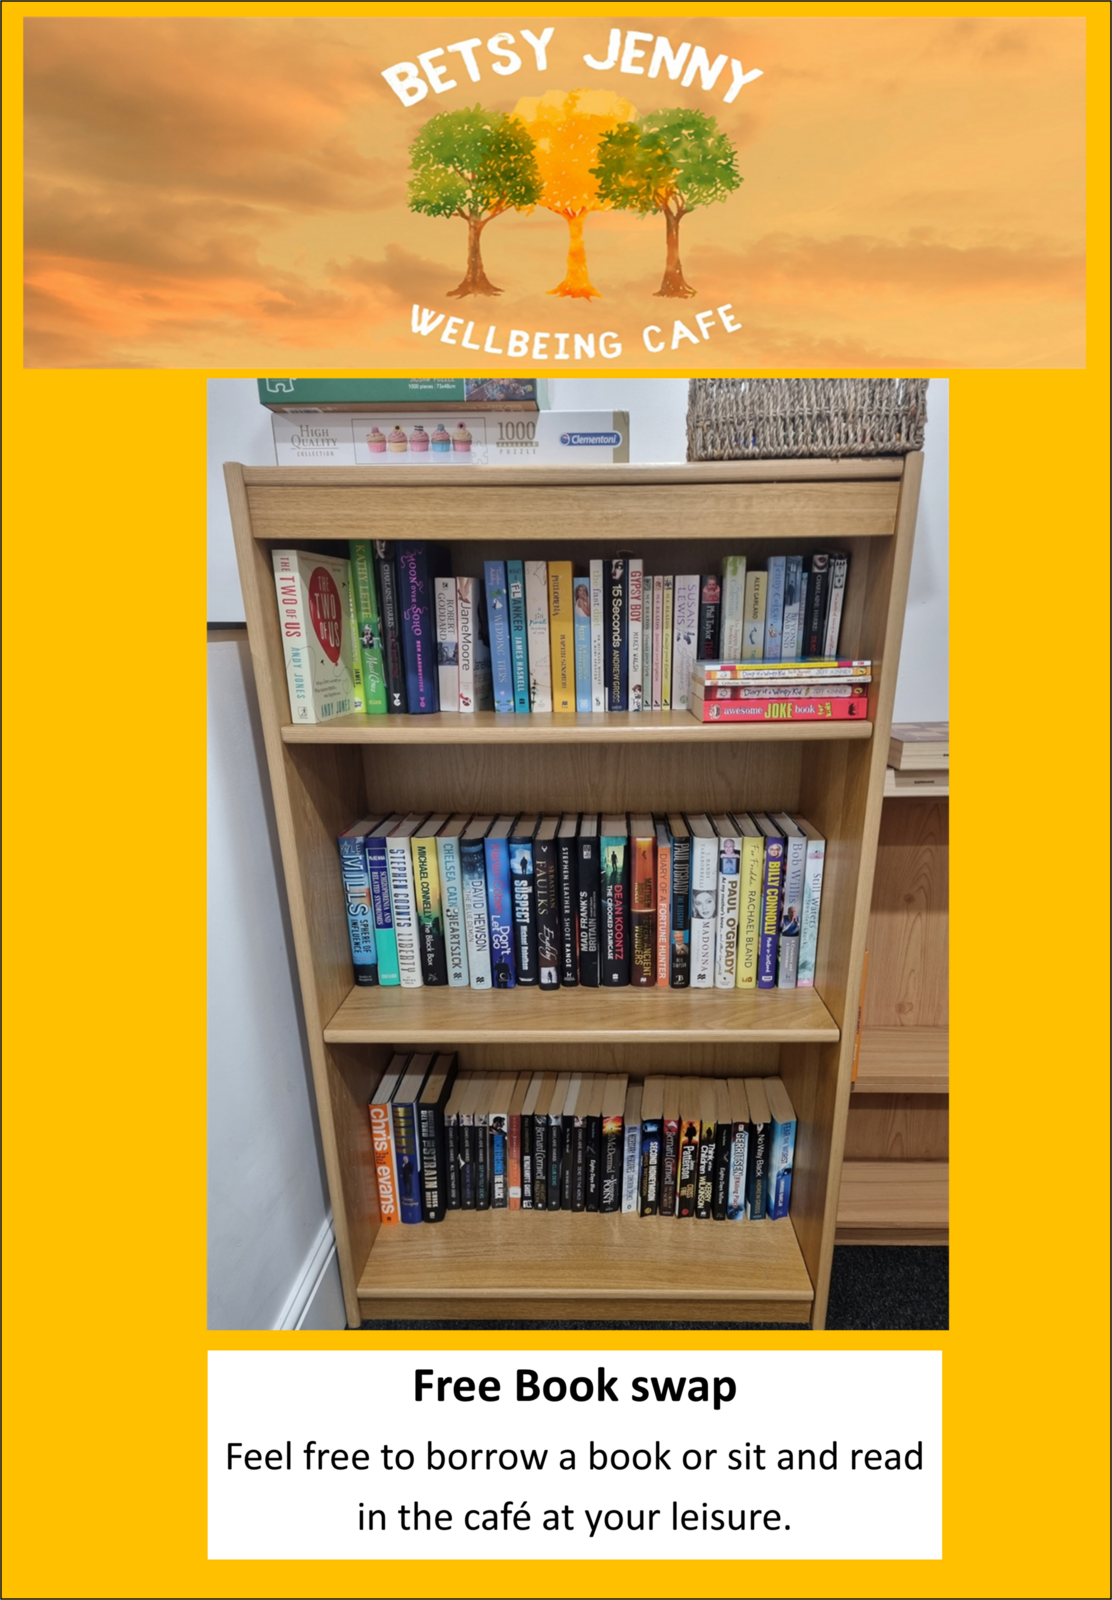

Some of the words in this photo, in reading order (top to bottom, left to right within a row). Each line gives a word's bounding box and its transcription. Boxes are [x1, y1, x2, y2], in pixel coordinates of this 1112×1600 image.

[291, 434, 338, 448] QUALITY
[300, 425, 329, 438] HIGH
[498, 421, 536, 441] 1000
[571, 434, 617, 445] Clementoni
[280, 557, 291, 572] THE
[355, 544, 368, 582] KATHY
[406, 551, 420, 585] MOON
[279, 576, 298, 605] TWO
[317, 575, 330, 592] THE
[612, 584, 622, 597] 15
[630, 570, 642, 602] GYPSY
[285, 609, 297, 619] OF
[314, 592, 337, 620] TWO
[359, 585, 372, 618] LETTE
[437, 592, 447, 641] GODDARD
[630, 603, 641, 623] BOY
[677, 587, 686, 625] LEWIS
[687, 584, 697, 628] SUSAN
[706, 605, 715, 618] Phil
[752, 592, 760, 619] GARLAND
[284, 621, 302, 638] US
[319, 617, 328, 640] OF
[327, 622, 340, 647] US
[408, 604, 423, 636] SOHO
[447, 599, 455, 635] ROBERT
[612, 598, 622, 648] Seconds
[703, 619, 714, 639] Taylor
[789, 612, 797, 649] BEYOND
[290, 646, 303, 668] ANDY
[515, 636, 524, 659] JAMES
[705, 641, 713, 655] THE
[353, 668, 362, 685] JAMES
[516, 661, 525, 692] HASKELL
[612, 649, 620, 681] ANDREW
[294, 673, 306, 699] JONES
[724, 706, 763, 715] awesome
[764, 702, 793, 719] JOKE
[795, 703, 815, 714] book
[389, 848, 406, 890] STEPHEN
[417, 846, 429, 881] MICHAEL
[443, 843, 457, 883] CHELSEA
[489, 843, 501, 879] Harlan
[659, 853, 667, 880] DIARY
[791, 843, 803, 866] Bob
[341, 854, 369, 917] MILLS
[372, 871, 380, 895] RELATED
[535, 860, 548, 915] FAULKS
[548, 865, 556, 909] SEBASTIAN
[659, 882, 667, 894] OF
[767, 861, 781, 886] BILLY
[789, 869, 802, 904] Willis
[811, 873, 821, 893] Still
[379, 870, 389, 910] SCHIZOPHRENIA
[420, 882, 432, 919] CONNELLY
[446, 886, 458, 908] CAIN
[471, 880, 484, 909] DAVID
[492, 880, 504, 915] Coben
[513, 880, 530, 923] SUSPECT
[614, 884, 624, 915] DEAN
[726, 880, 738, 913] PAUL
[373, 895, 383, 925] SYNDROMES
[383, 912, 391, 923] AND
[394, 892, 411, 928] COONTS
[465, 903, 473, 919] BLUE
[491, 914, 500, 931] Let
[579, 891, 588, 929] FRANK'S
[659, 902, 667, 943] FORTUNE
[746, 890, 756, 935] RACHAEL
[764, 888, 779, 935] CONNOLLY
[808, 896, 820, 929] Waters
[351, 919, 362, 954] INFLUENCE
[359, 919, 370, 943] SPHERE
[424, 922, 432, 934] The
[425, 934, 433, 952] Black
[449, 915, 462, 969] HEARTSICK
[473, 913, 487, 952] HEWSON
[492, 934, 502, 949] Go
[498, 925, 511, 955] Don't
[520, 925, 529, 945] Michael
[580, 931, 588, 952] MAD
[588, 917, 597, 952] BRITAIN
[614, 916, 624, 960] KOONTZ
[362, 945, 372, 953] OF
[397, 932, 416, 973] LIBERTY
[520, 946, 529, 971] Robotham
[538, 925, 558, 962] Engleby
[634, 925, 644, 966] WONDERS
[700, 921, 710, 972] MADONNA
[724, 917, 737, 976] O'GRADY
[744, 937, 755, 969] BLAND
[426, 953, 434, 966] Box
[659, 945, 667, 979] HUNTER
[370, 1108, 390, 1152] chris
[757, 1133, 765, 1144] No
[649, 1141, 658, 1165] SECOND
[681, 1145, 694, 1180] Patterson
[699, 1145, 708, 1174] Children
[707, 1142, 716, 1161] Think
[732, 1132, 745, 1177] GERRITSEN
[755, 1145, 765, 1159] Way
[422, 1147, 438, 1189] STRAIN
[718, 1167, 726, 1181] Eighty
[755, 1160, 765, 1178] Back
[377, 1166, 394, 1214] evans
[602, 1179, 611, 1205] POINT
[647, 1165, 657, 1202] HONEYMOON
[697, 1175, 707, 1209] WILKINSON
[704, 1181, 712, 1202] KERRY
